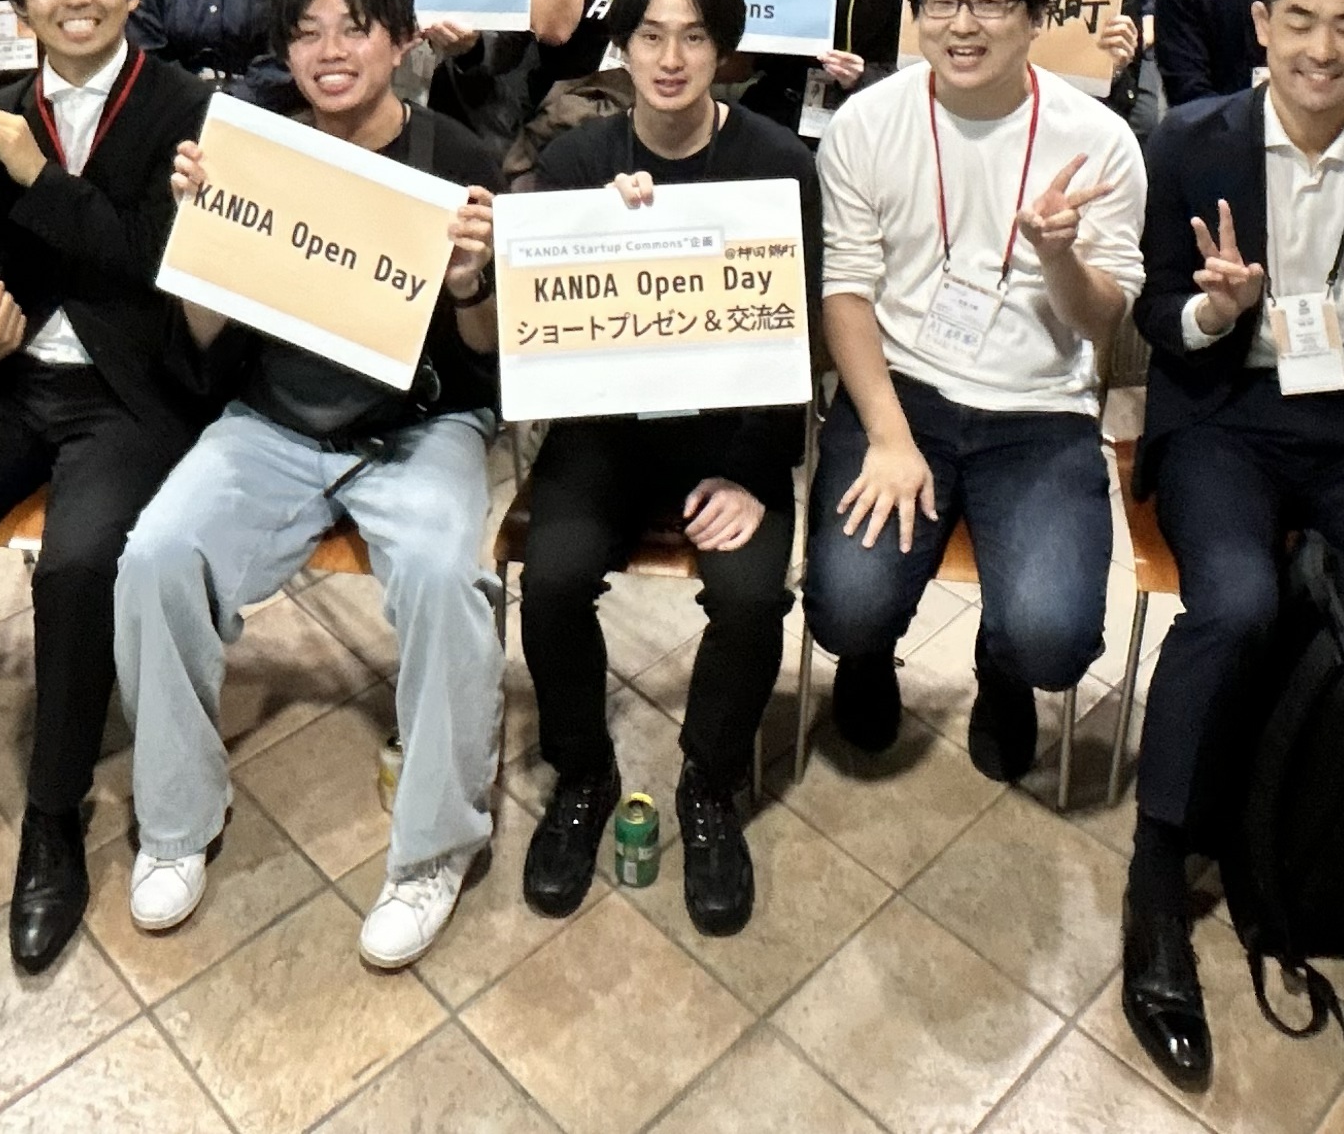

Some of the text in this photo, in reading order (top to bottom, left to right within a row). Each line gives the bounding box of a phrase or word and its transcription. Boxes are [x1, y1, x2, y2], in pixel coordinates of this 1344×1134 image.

[193, 182, 427, 302] KANDA Open Day
[574, 242, 621, 255] Startup
[534, 266, 773, 303] KANDA Open Day
